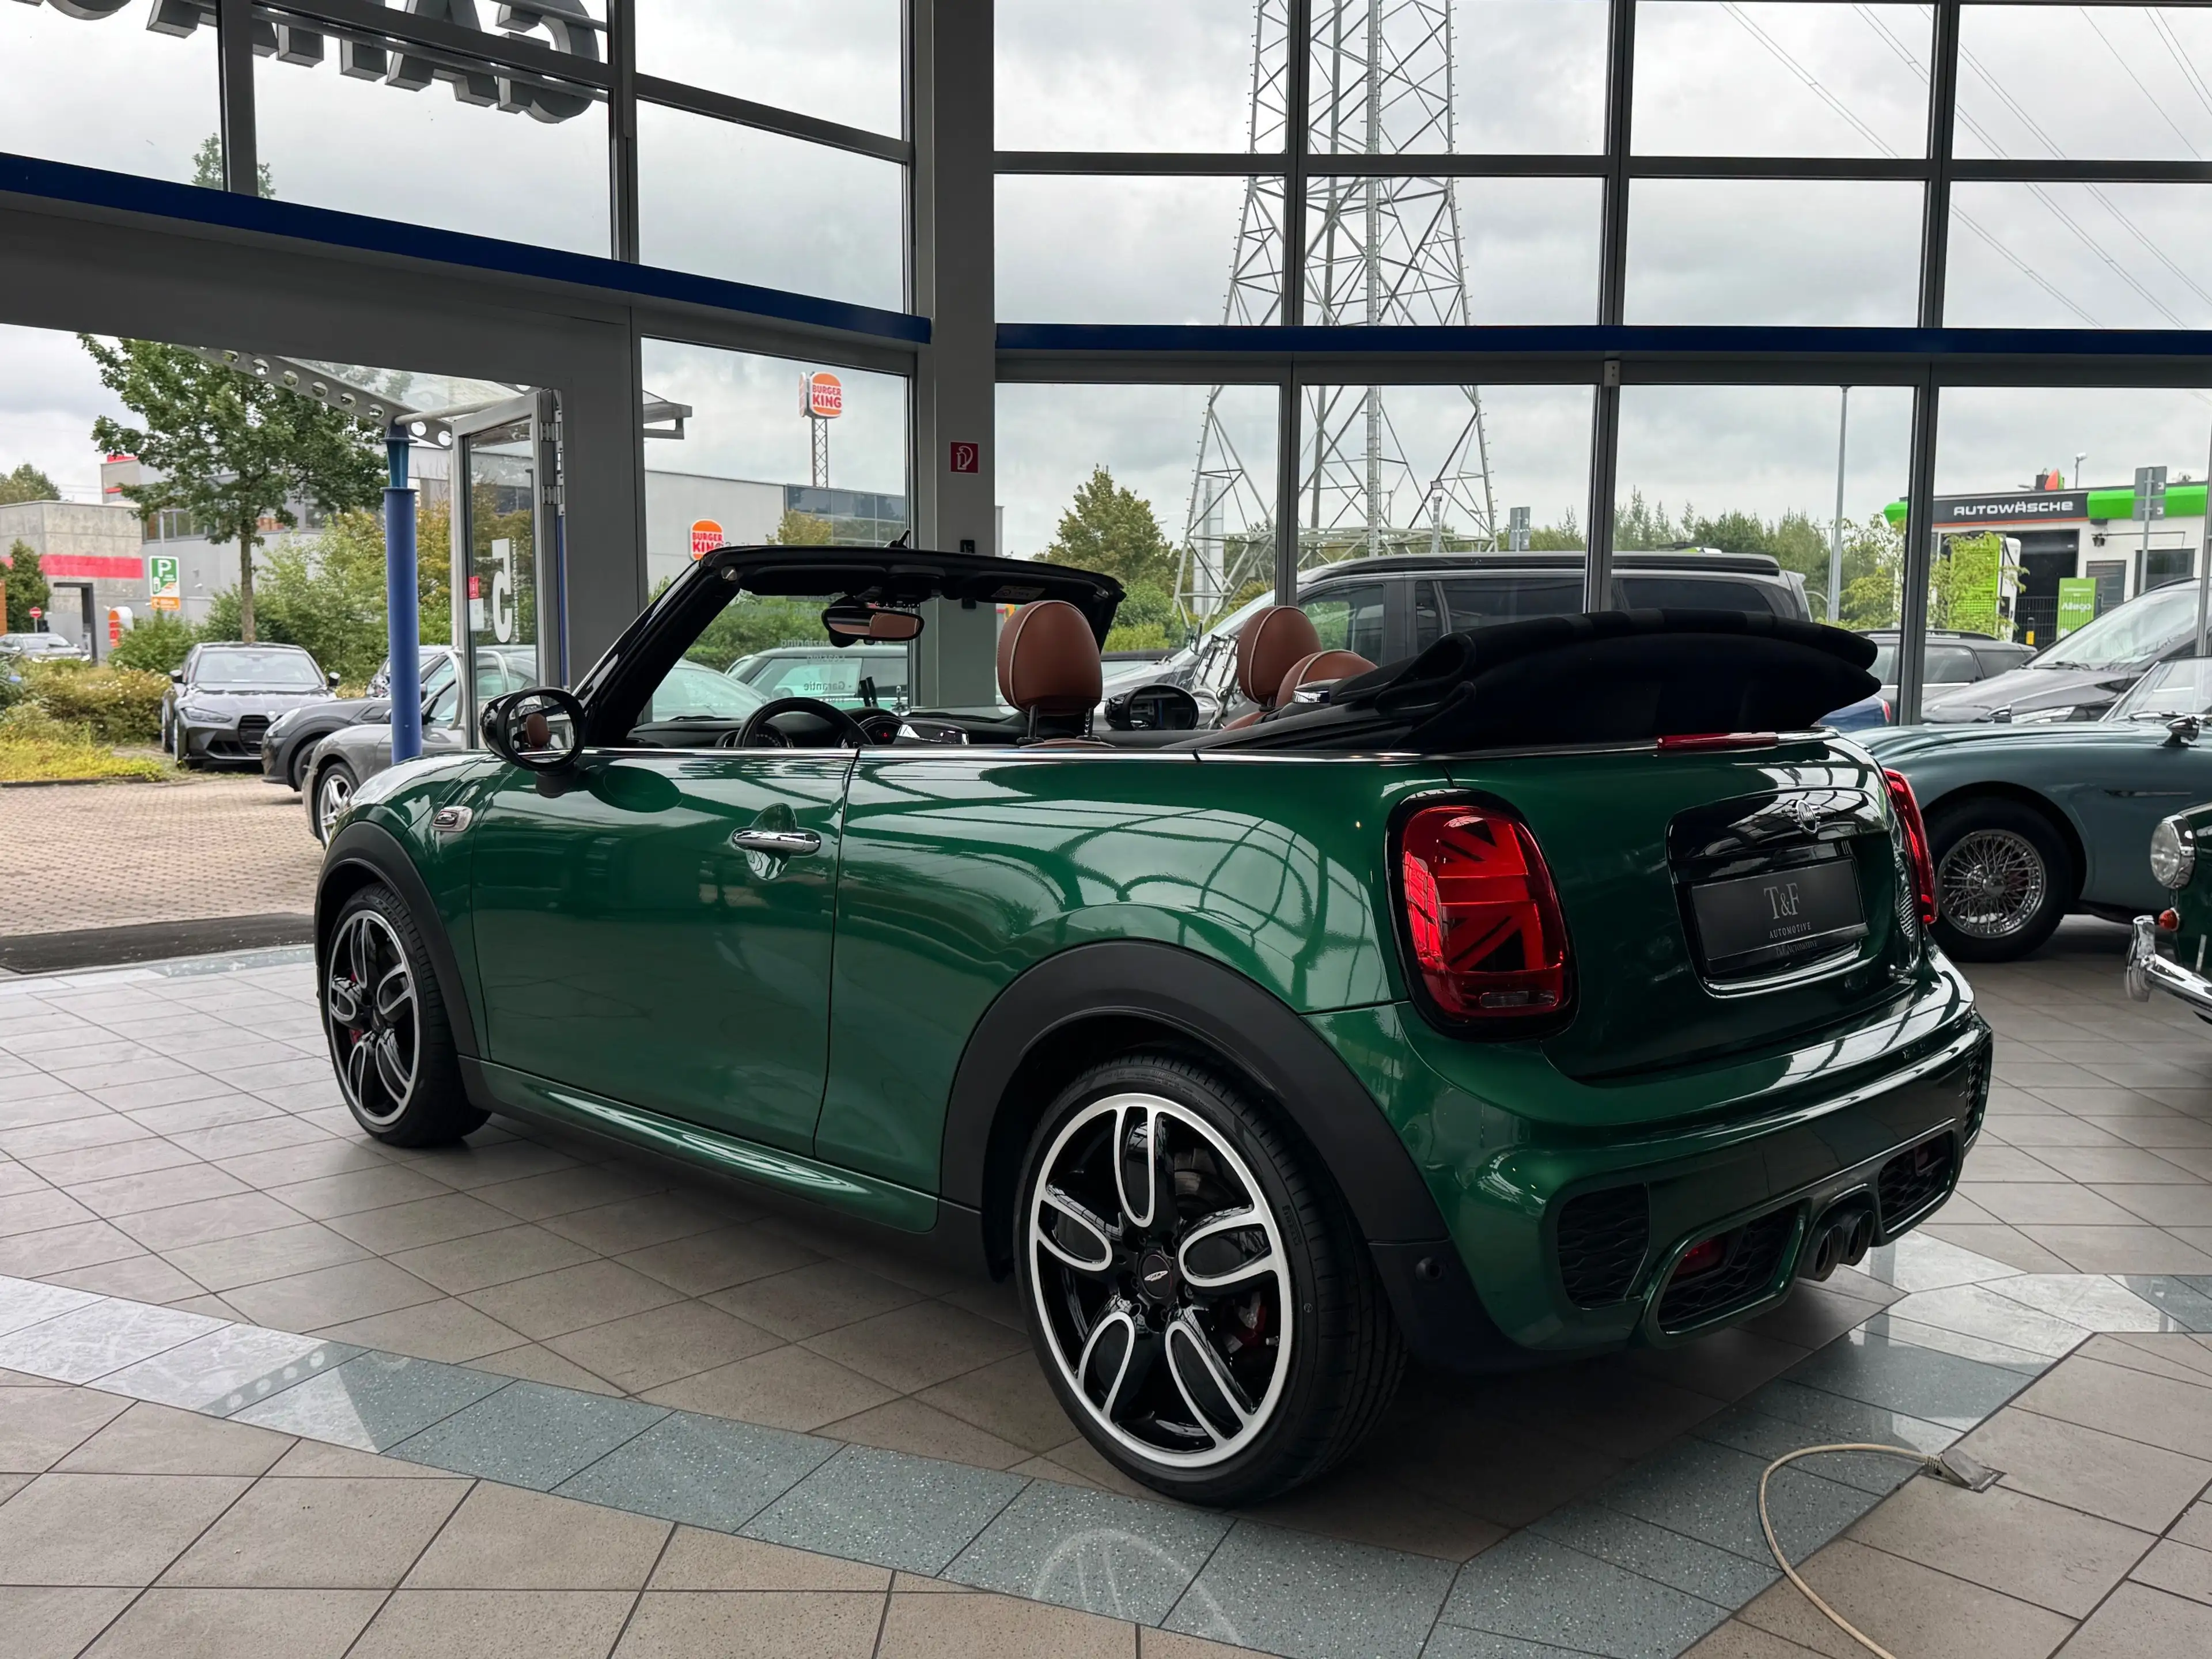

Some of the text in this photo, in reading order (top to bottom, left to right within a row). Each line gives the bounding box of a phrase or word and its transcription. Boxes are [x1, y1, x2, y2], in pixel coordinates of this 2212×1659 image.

[813, 385, 842, 396] BURGER
[813, 394, 842, 408] KING
[692, 532, 723, 542] BURGER
[692, 540, 724, 552] KIN
[157, 559, 172, 577] P
[1763, 882, 1800, 920] T&F
[1769, 922, 1812, 939] AUTOMOTIVE
